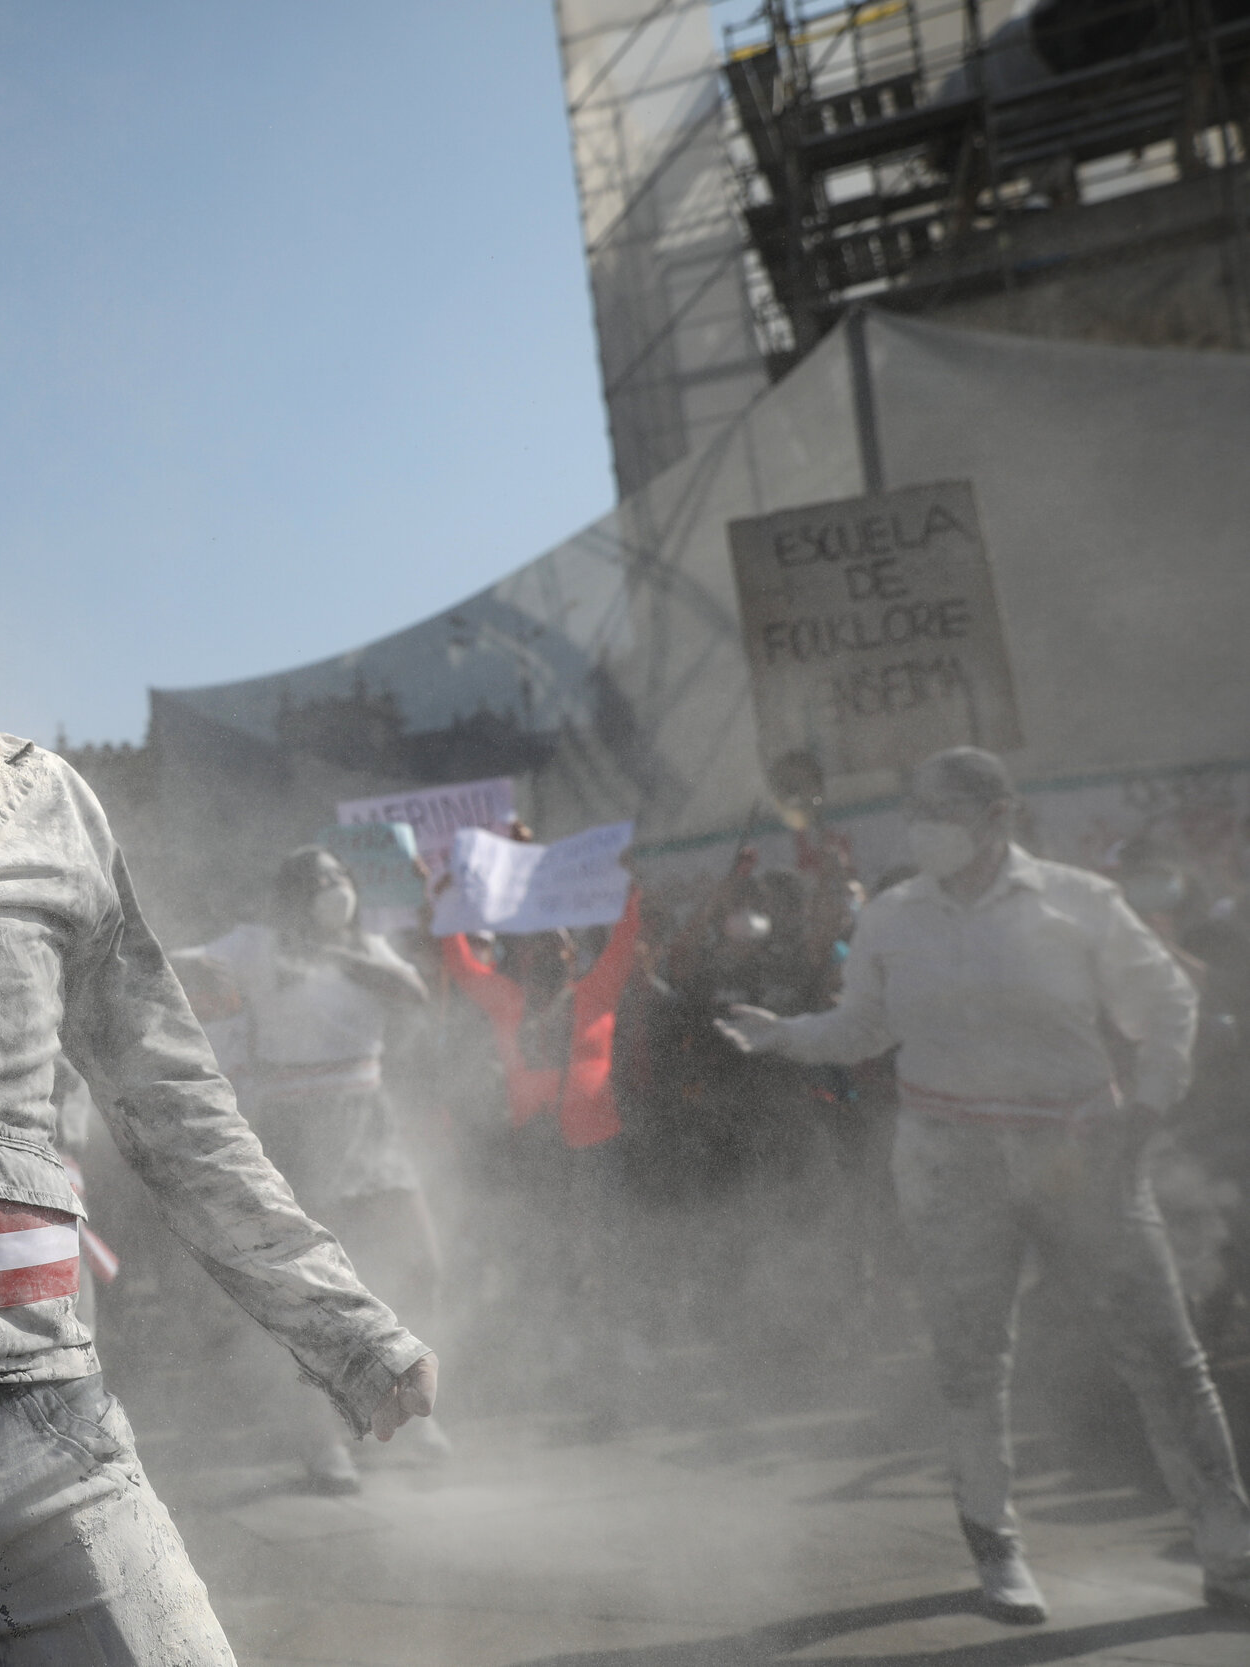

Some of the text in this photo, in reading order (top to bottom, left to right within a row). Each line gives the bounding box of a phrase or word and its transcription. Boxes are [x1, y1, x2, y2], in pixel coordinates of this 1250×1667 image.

[773, 502, 981, 568] ESCUELA
[844, 557, 910, 602] DE
[761, 599, 973, 668] FOLKLORE
